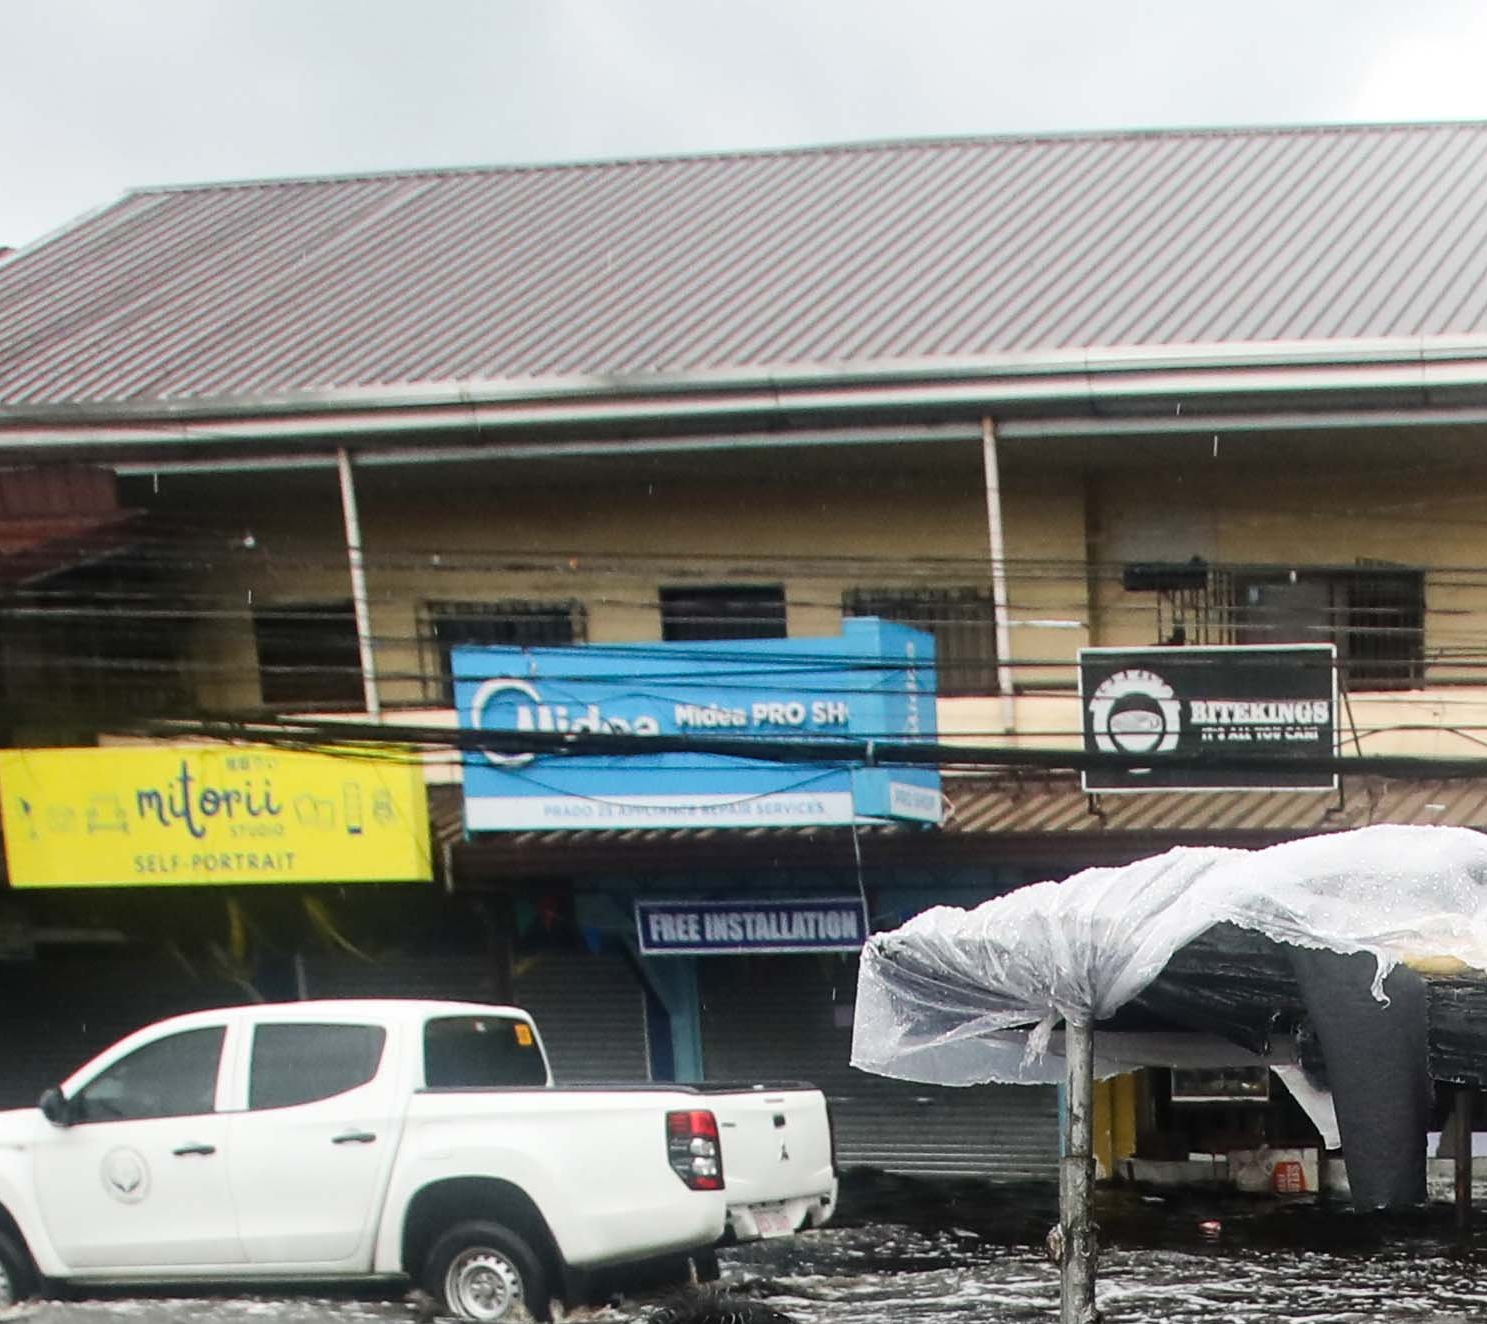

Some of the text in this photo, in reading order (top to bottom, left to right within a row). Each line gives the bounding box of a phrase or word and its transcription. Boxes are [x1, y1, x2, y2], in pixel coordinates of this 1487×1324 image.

[674, 701, 849, 727] Midea PRO SH
[1189, 700, 1330, 724] BITEKINGS
[1227, 726, 1251, 741] ALL
[1255, 726, 1281, 740] YOU
[136, 759, 282, 838] mitorii
[756, 800, 825, 816] SERVICES
[133, 851, 296, 873] SELF-PORTRAIT
[648, 910, 858, 942] FREE INSTALLATION
